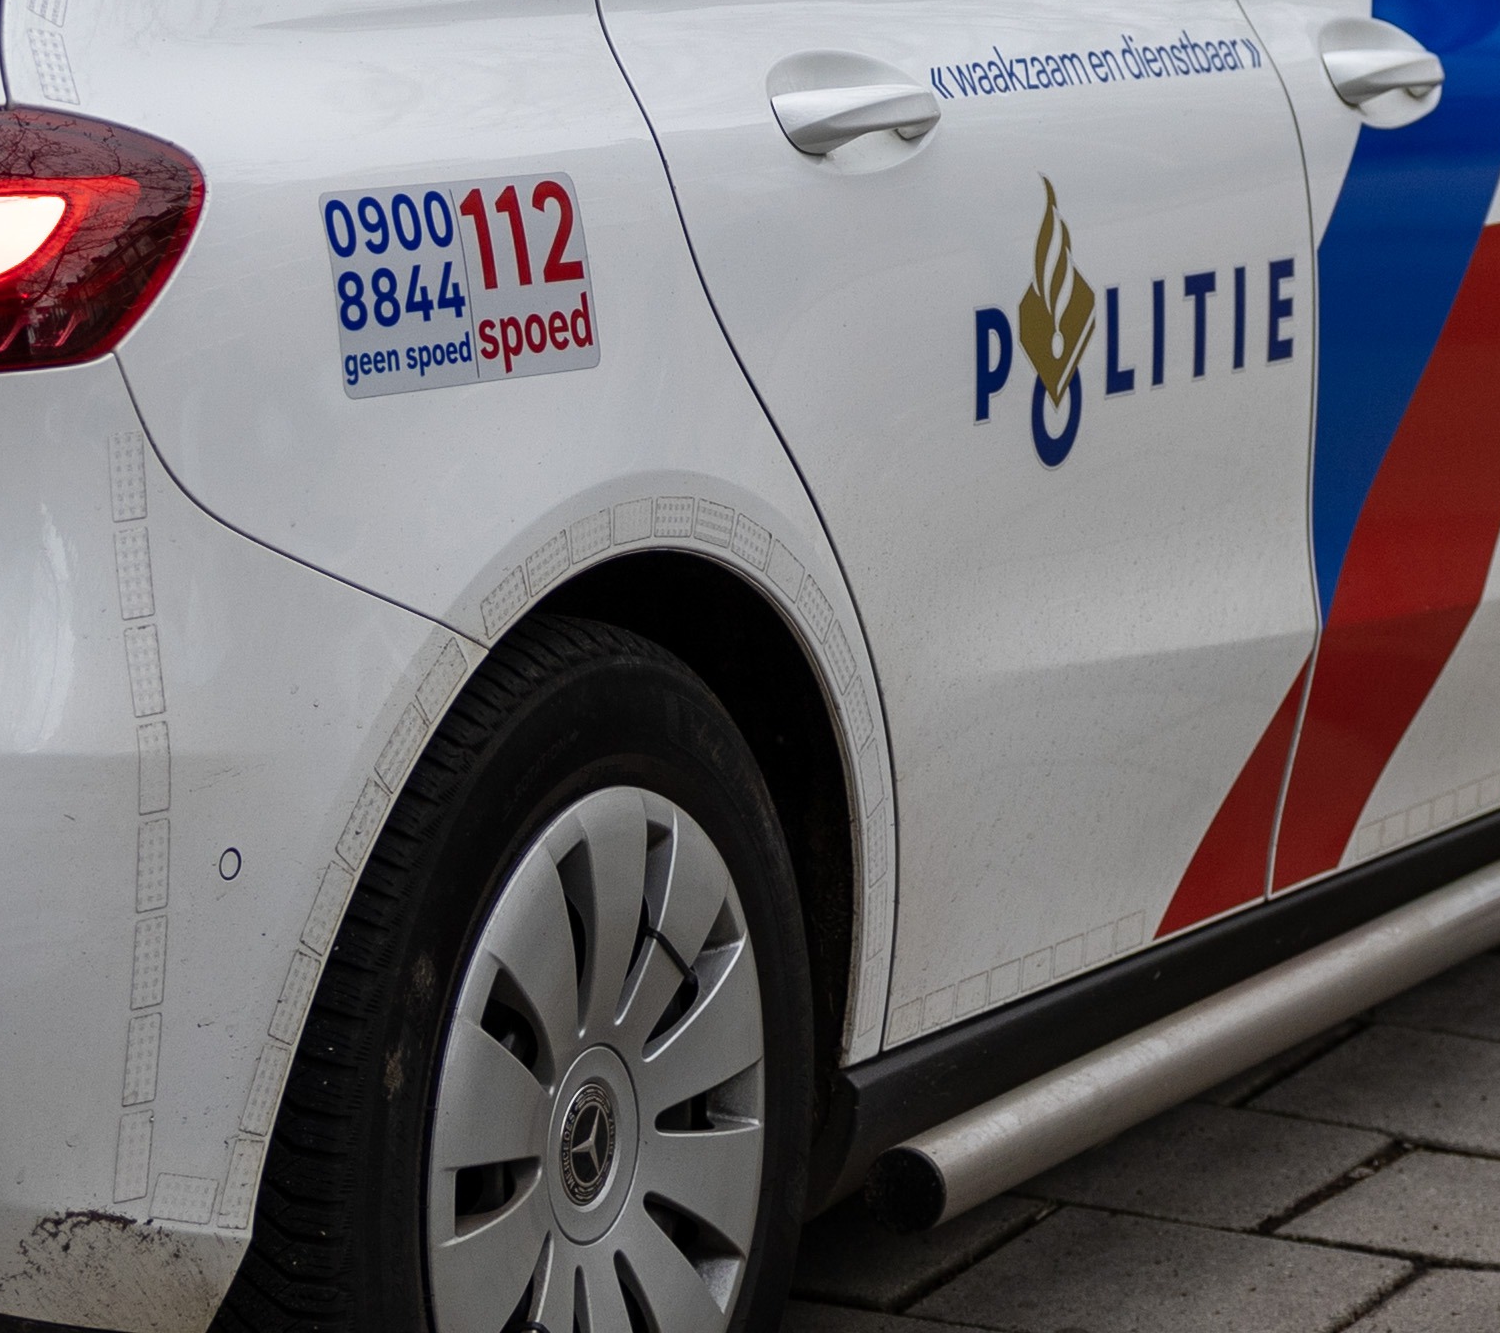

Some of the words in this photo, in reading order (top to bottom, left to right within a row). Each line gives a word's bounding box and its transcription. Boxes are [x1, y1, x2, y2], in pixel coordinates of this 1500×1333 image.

[1089, 46, 1125, 83] en
[324, 190, 454, 258] 0900
[460, 180, 585, 290] 112
[337, 261, 466, 331] 8844
[344, 342, 401, 385] geen
[406, 331, 472, 377] spoed
[478, 291, 594, 373] spoed
